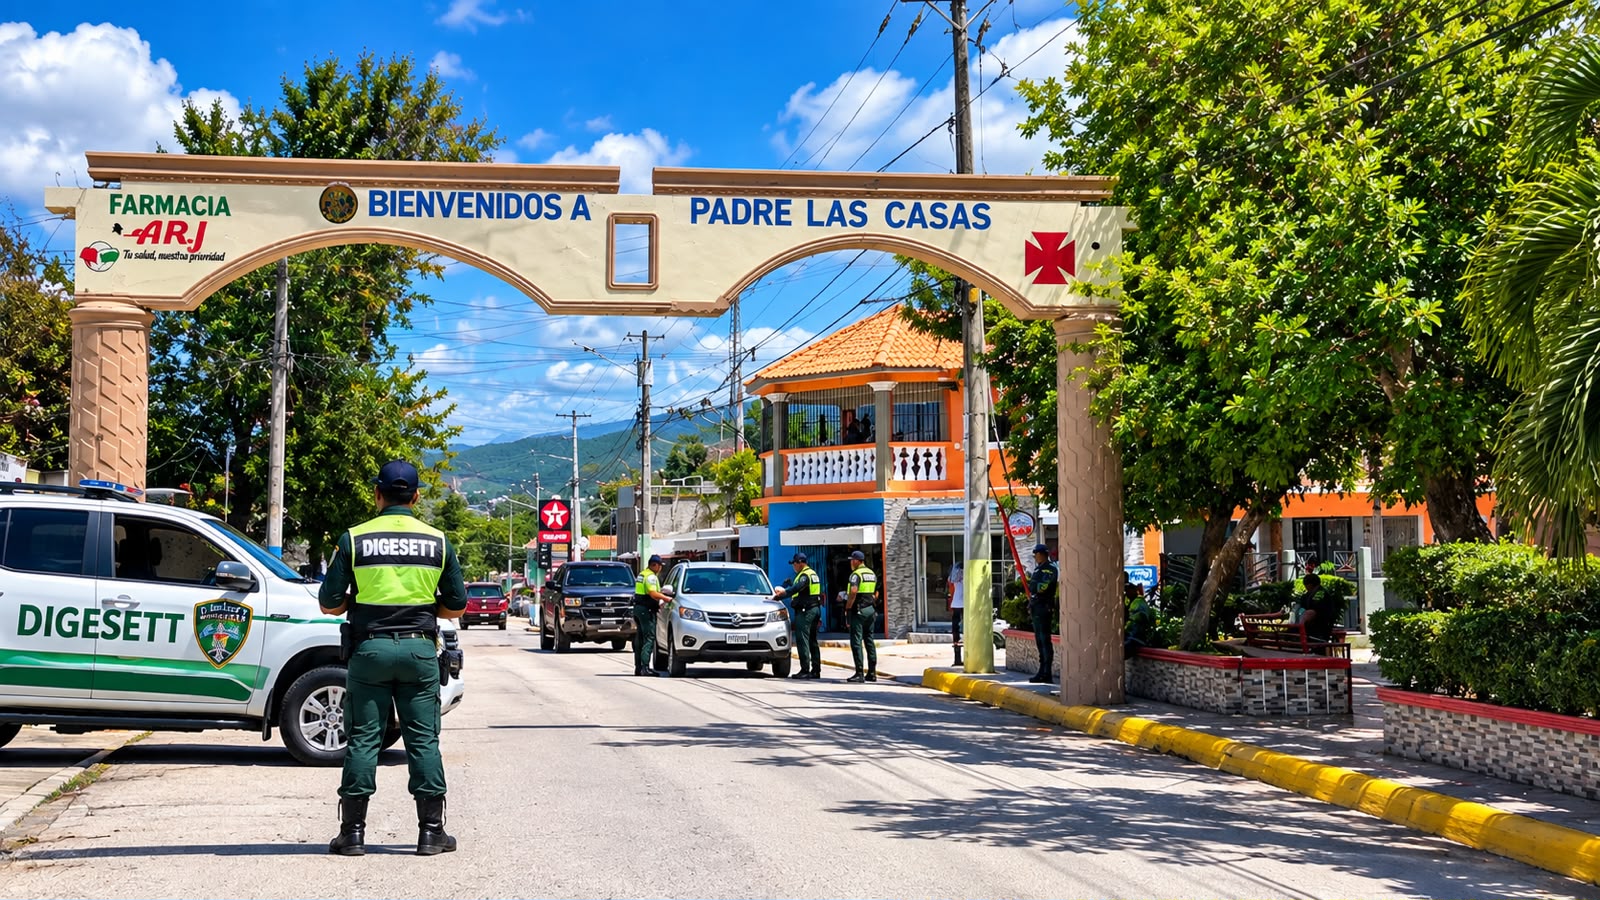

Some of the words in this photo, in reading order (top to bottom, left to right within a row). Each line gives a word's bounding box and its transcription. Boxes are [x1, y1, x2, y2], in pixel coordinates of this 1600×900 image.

[110, 193, 231, 216] FARMACIA
[368, 190, 562, 220] BIENVENIDOS
[570, 195, 592, 221] A
[690, 197, 792, 226] PADRE
[807, 199, 868, 227] LAS
[884, 201, 992, 230] CASAS
[123, 249, 133, 259] Tu
[134, 250, 156, 262] salud,
[362, 538, 437, 558] DIGESETT
[17, 604, 185, 643] DIGESETT
